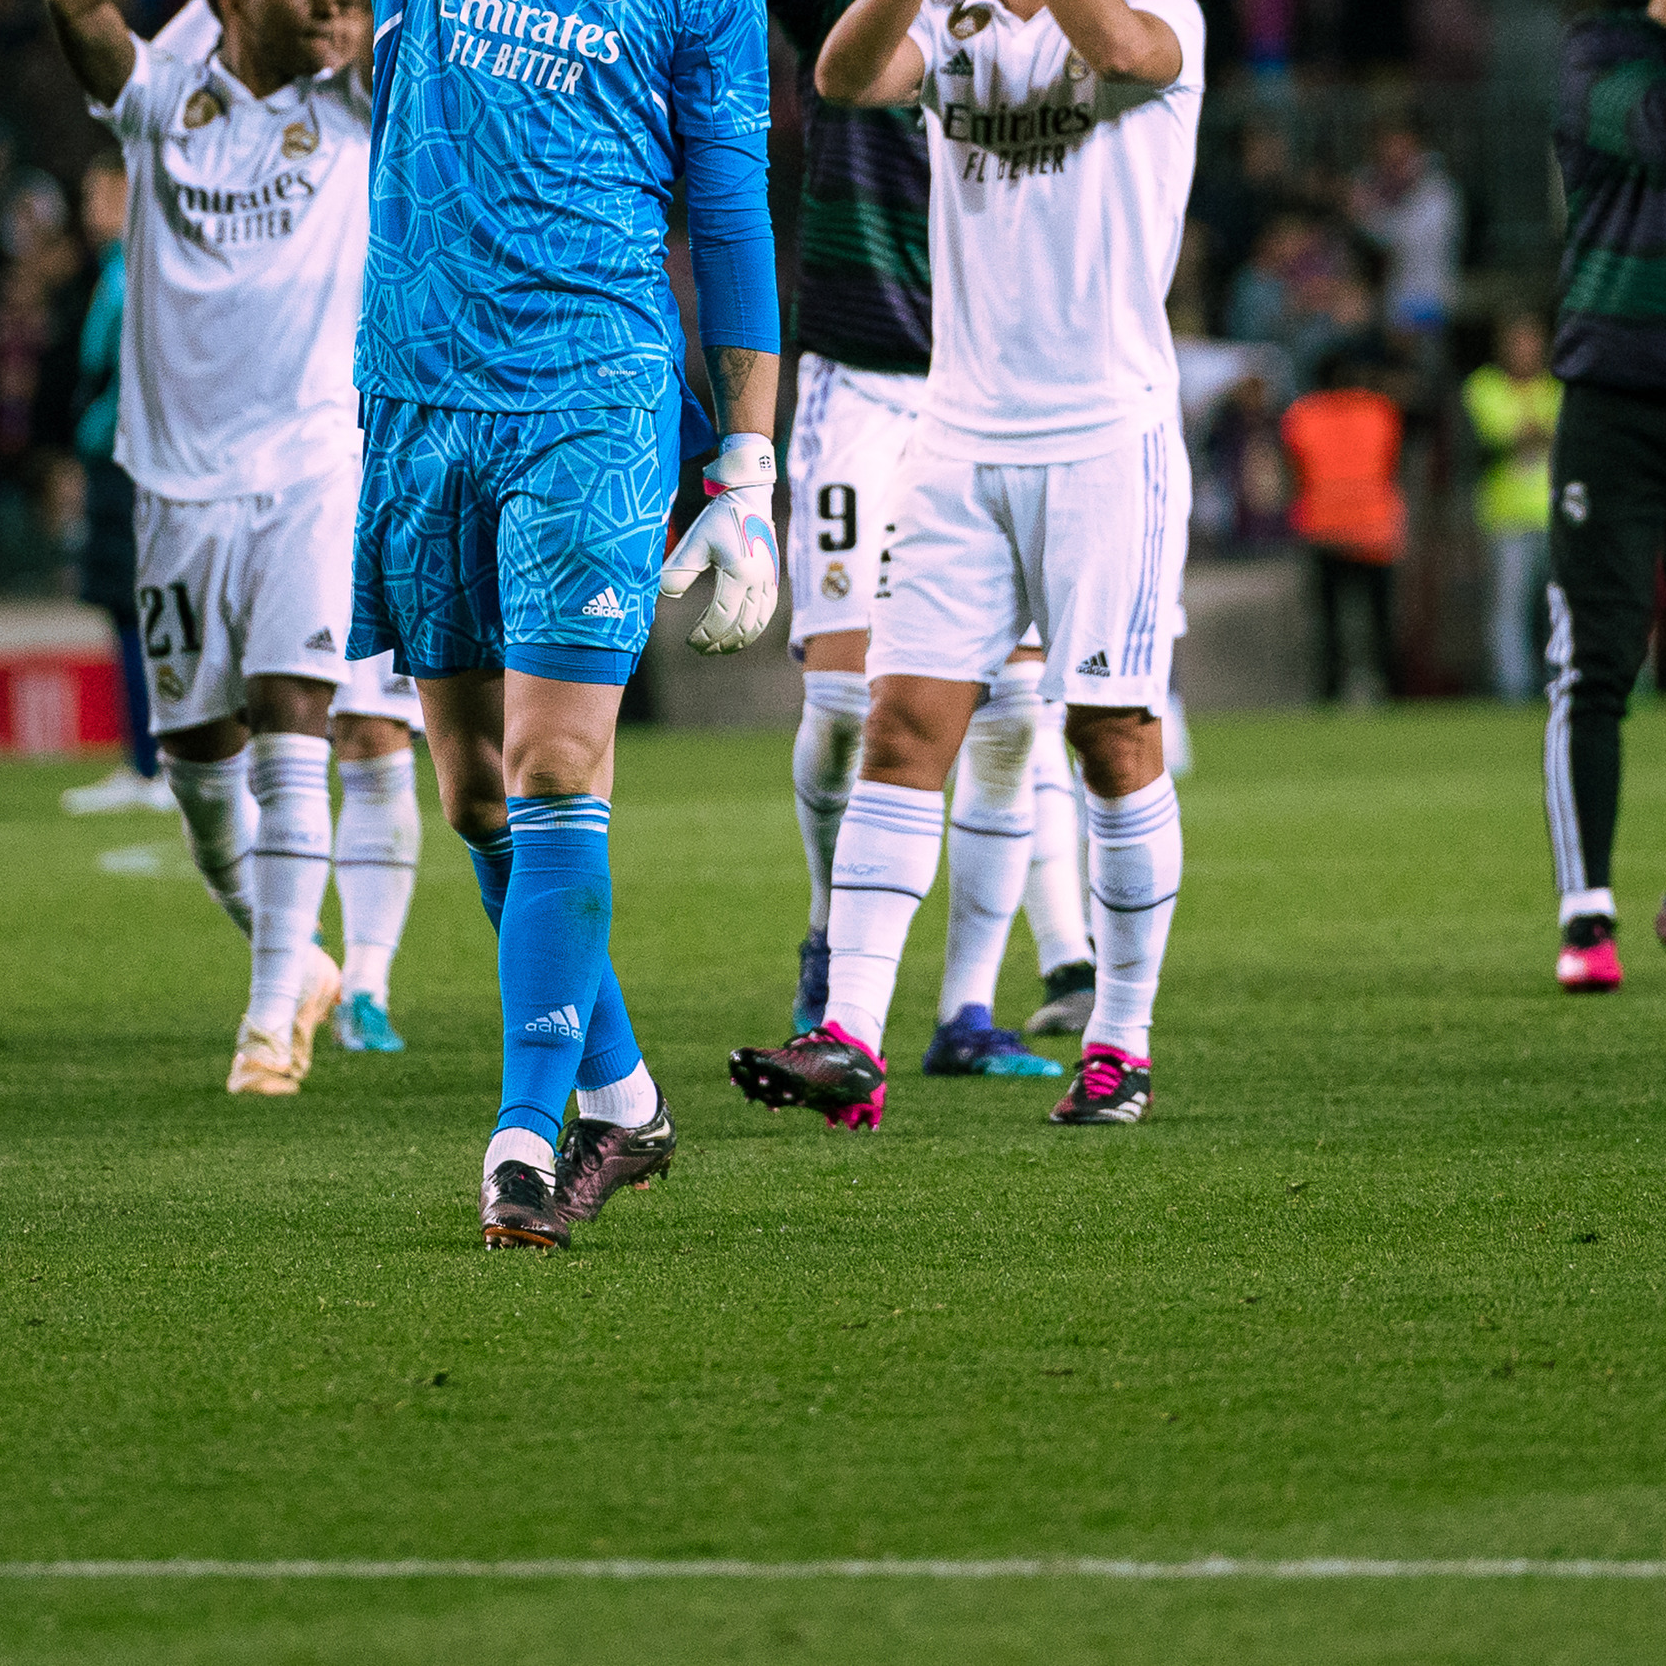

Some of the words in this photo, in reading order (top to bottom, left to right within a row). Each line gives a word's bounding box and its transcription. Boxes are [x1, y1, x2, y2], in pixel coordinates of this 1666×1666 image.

[448, 29, 492, 70] FLY
[491, 42, 585, 96] BETTER
[182, 172, 315, 214] mirates
[818, 483, 856, 552] 9
[140, 580, 201, 657] 21
[581, 604, 625, 619] adidas
[524, 1020, 584, 1043] adidas
